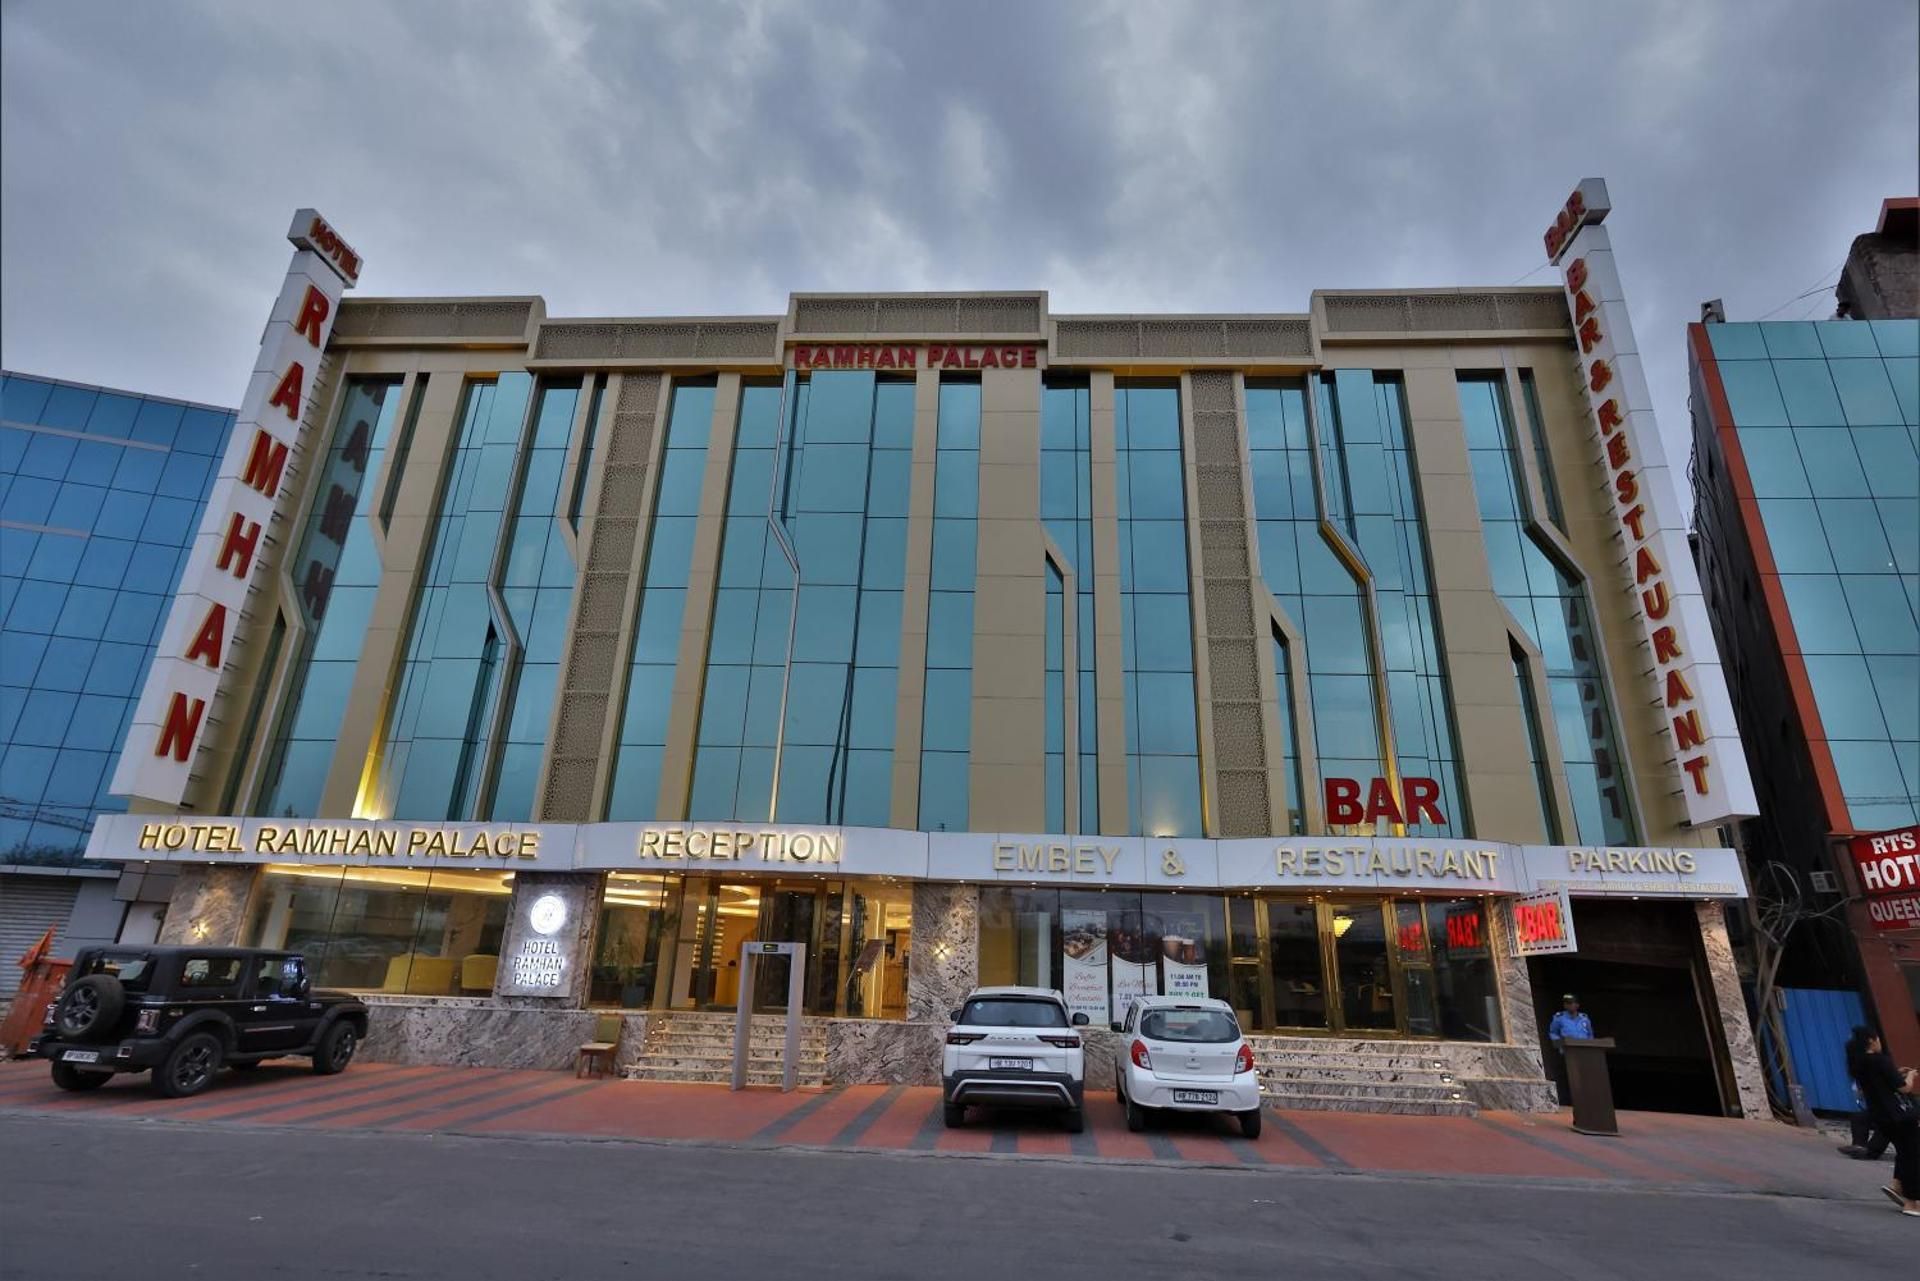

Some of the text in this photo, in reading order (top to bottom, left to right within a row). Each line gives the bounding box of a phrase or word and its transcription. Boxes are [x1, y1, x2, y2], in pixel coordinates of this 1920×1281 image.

[1544, 191, 1586, 258] BAR
[310, 217, 358, 279] HOTEL
[1567, 258, 1603, 353] BAR
[793, 344, 1037, 368] RAMHAN PALACE
[1590, 360, 1612, 392] &
[155, 285, 328, 762] RAMHAN
[1598, 399, 1709, 795] RESTAURANT
[1324, 777, 1447, 825] BAR
[138, 824, 539, 859] HOTEL RAMHAN PALACE
[640, 830, 842, 862] RECEPTION
[1870, 832, 1916, 854] RTS
[993, 842, 1499, 880] EMBEY & RESTAURANT
[1569, 850, 1696, 873] PARKING
[513, 957, 563, 970] RAMHAN
[522, 941, 557, 954] HOTEL
[513, 973, 557, 986] PALACE
